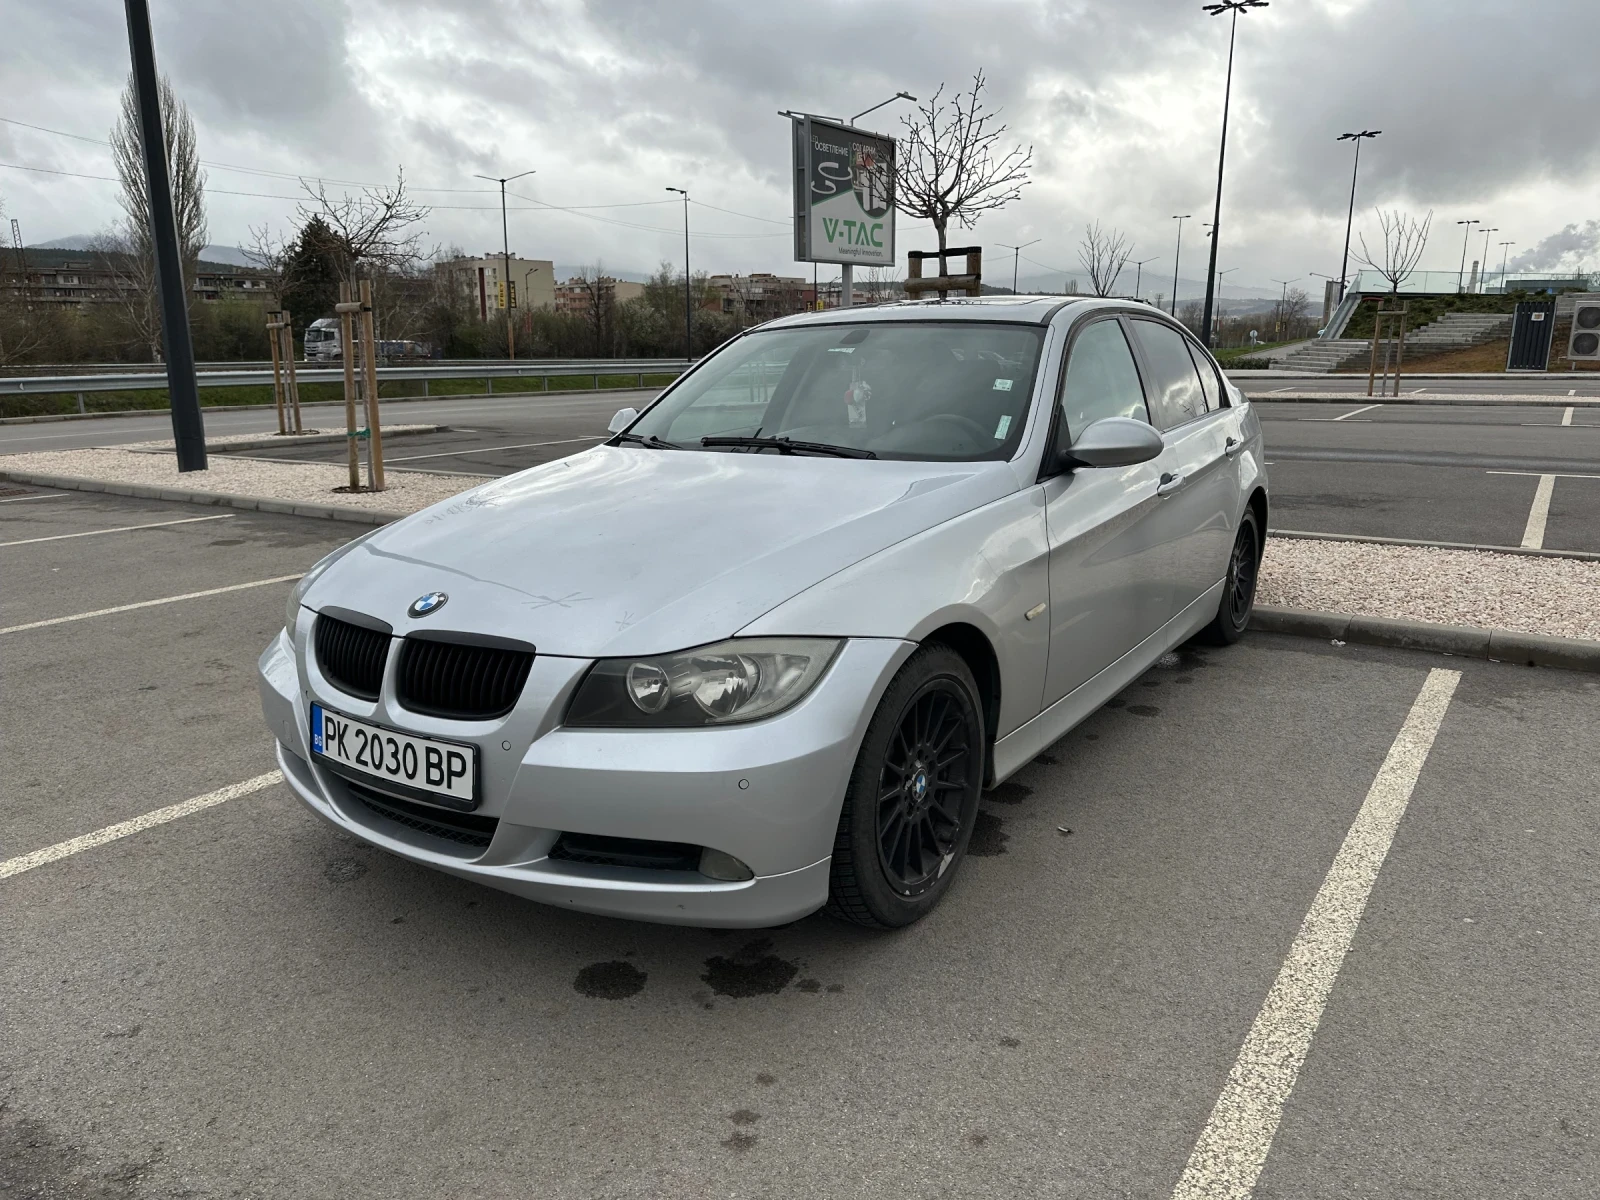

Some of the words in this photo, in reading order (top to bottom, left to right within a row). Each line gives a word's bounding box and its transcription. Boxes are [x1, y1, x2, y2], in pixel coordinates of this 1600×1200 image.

[815, 142, 848, 156] ОСВЕТЛЕНИЕ
[822, 217, 884, 248] V-TAC
[839, 247, 861, 257] Meaningful
[314, 733, 323, 746] BG
[324, 715, 350, 761] PK
[354, 728, 418, 780] 2030
[425, 746, 467, 790] BP
